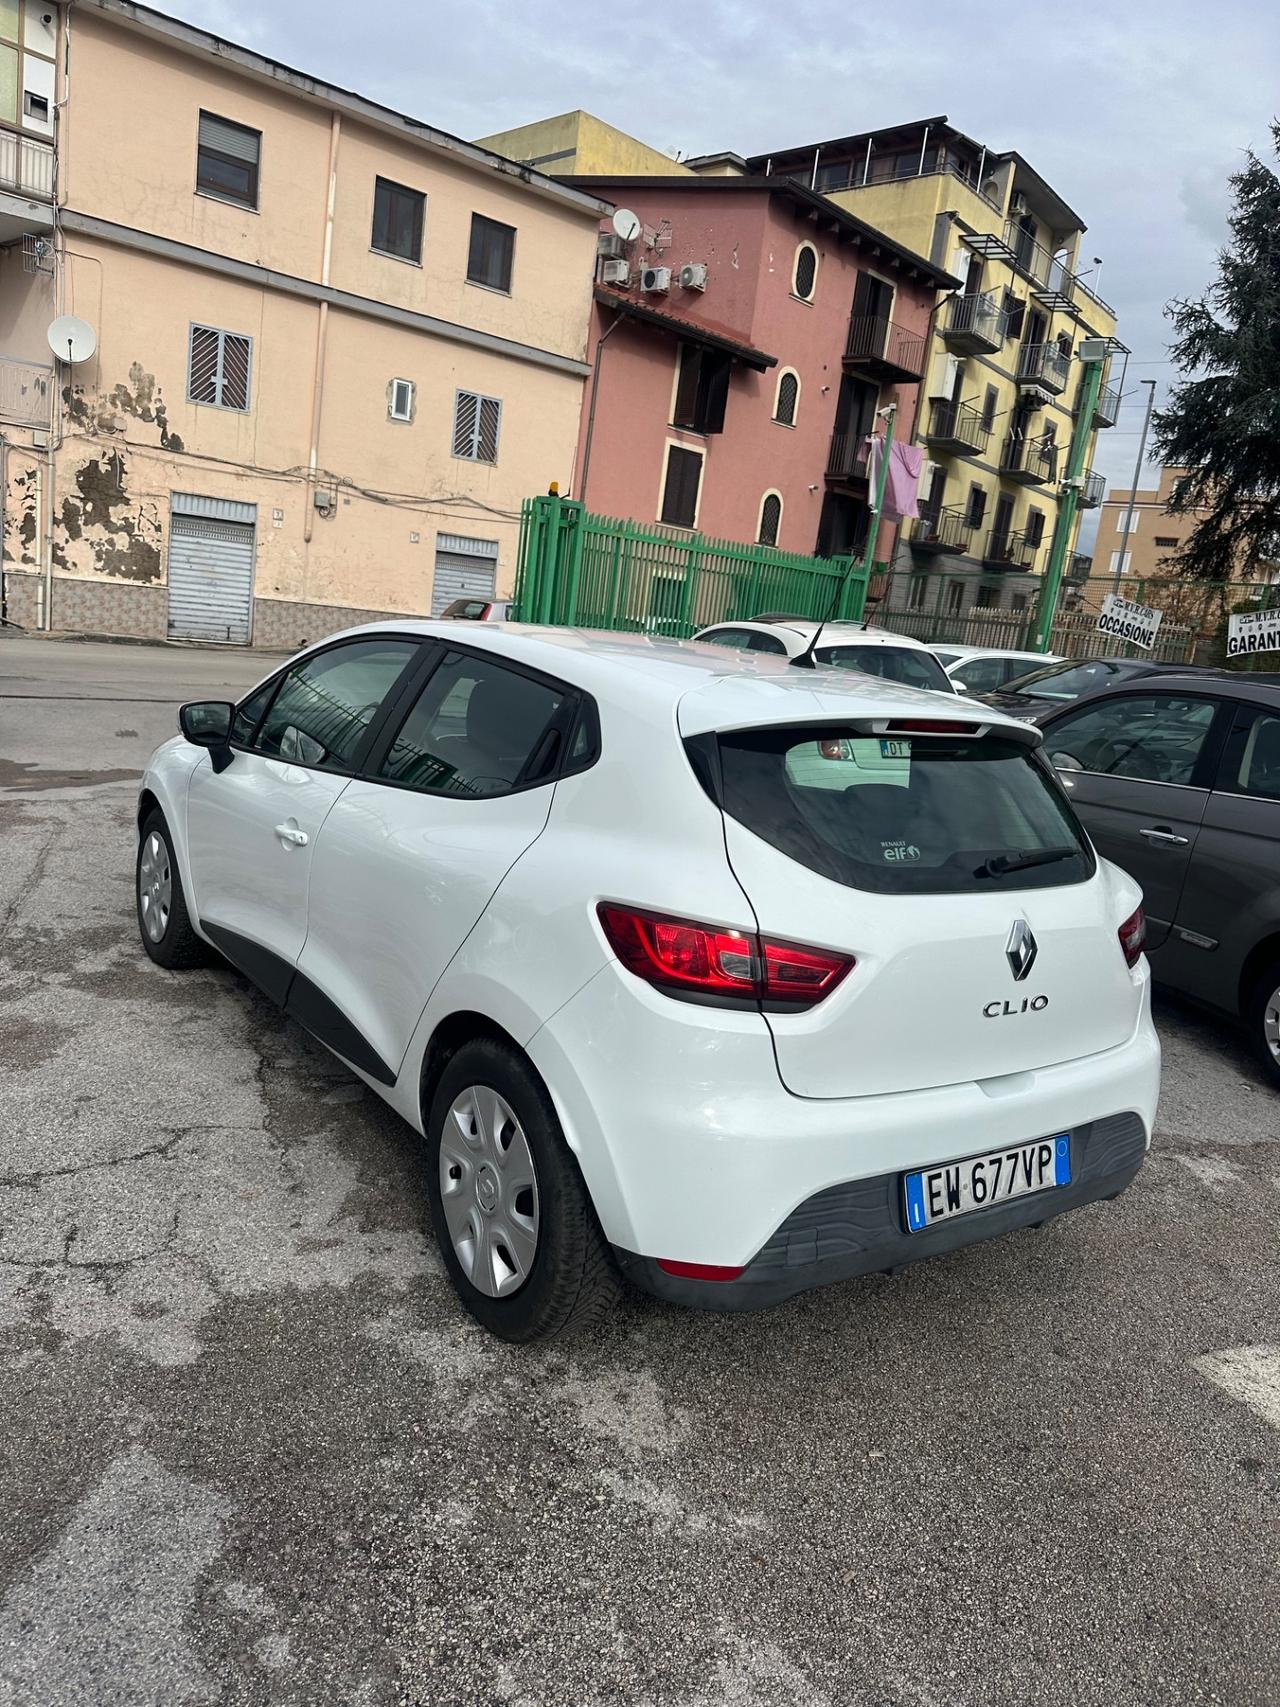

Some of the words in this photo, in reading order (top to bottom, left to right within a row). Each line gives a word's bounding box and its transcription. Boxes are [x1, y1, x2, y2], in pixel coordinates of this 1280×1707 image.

[1099, 613, 1154, 647] OCCASIONE
[889, 742, 903, 756] DT
[983, 995, 1049, 1018] CLIO
[927, 1166, 961, 1218] EW
[971, 1144, 1052, 1203] 677VP
